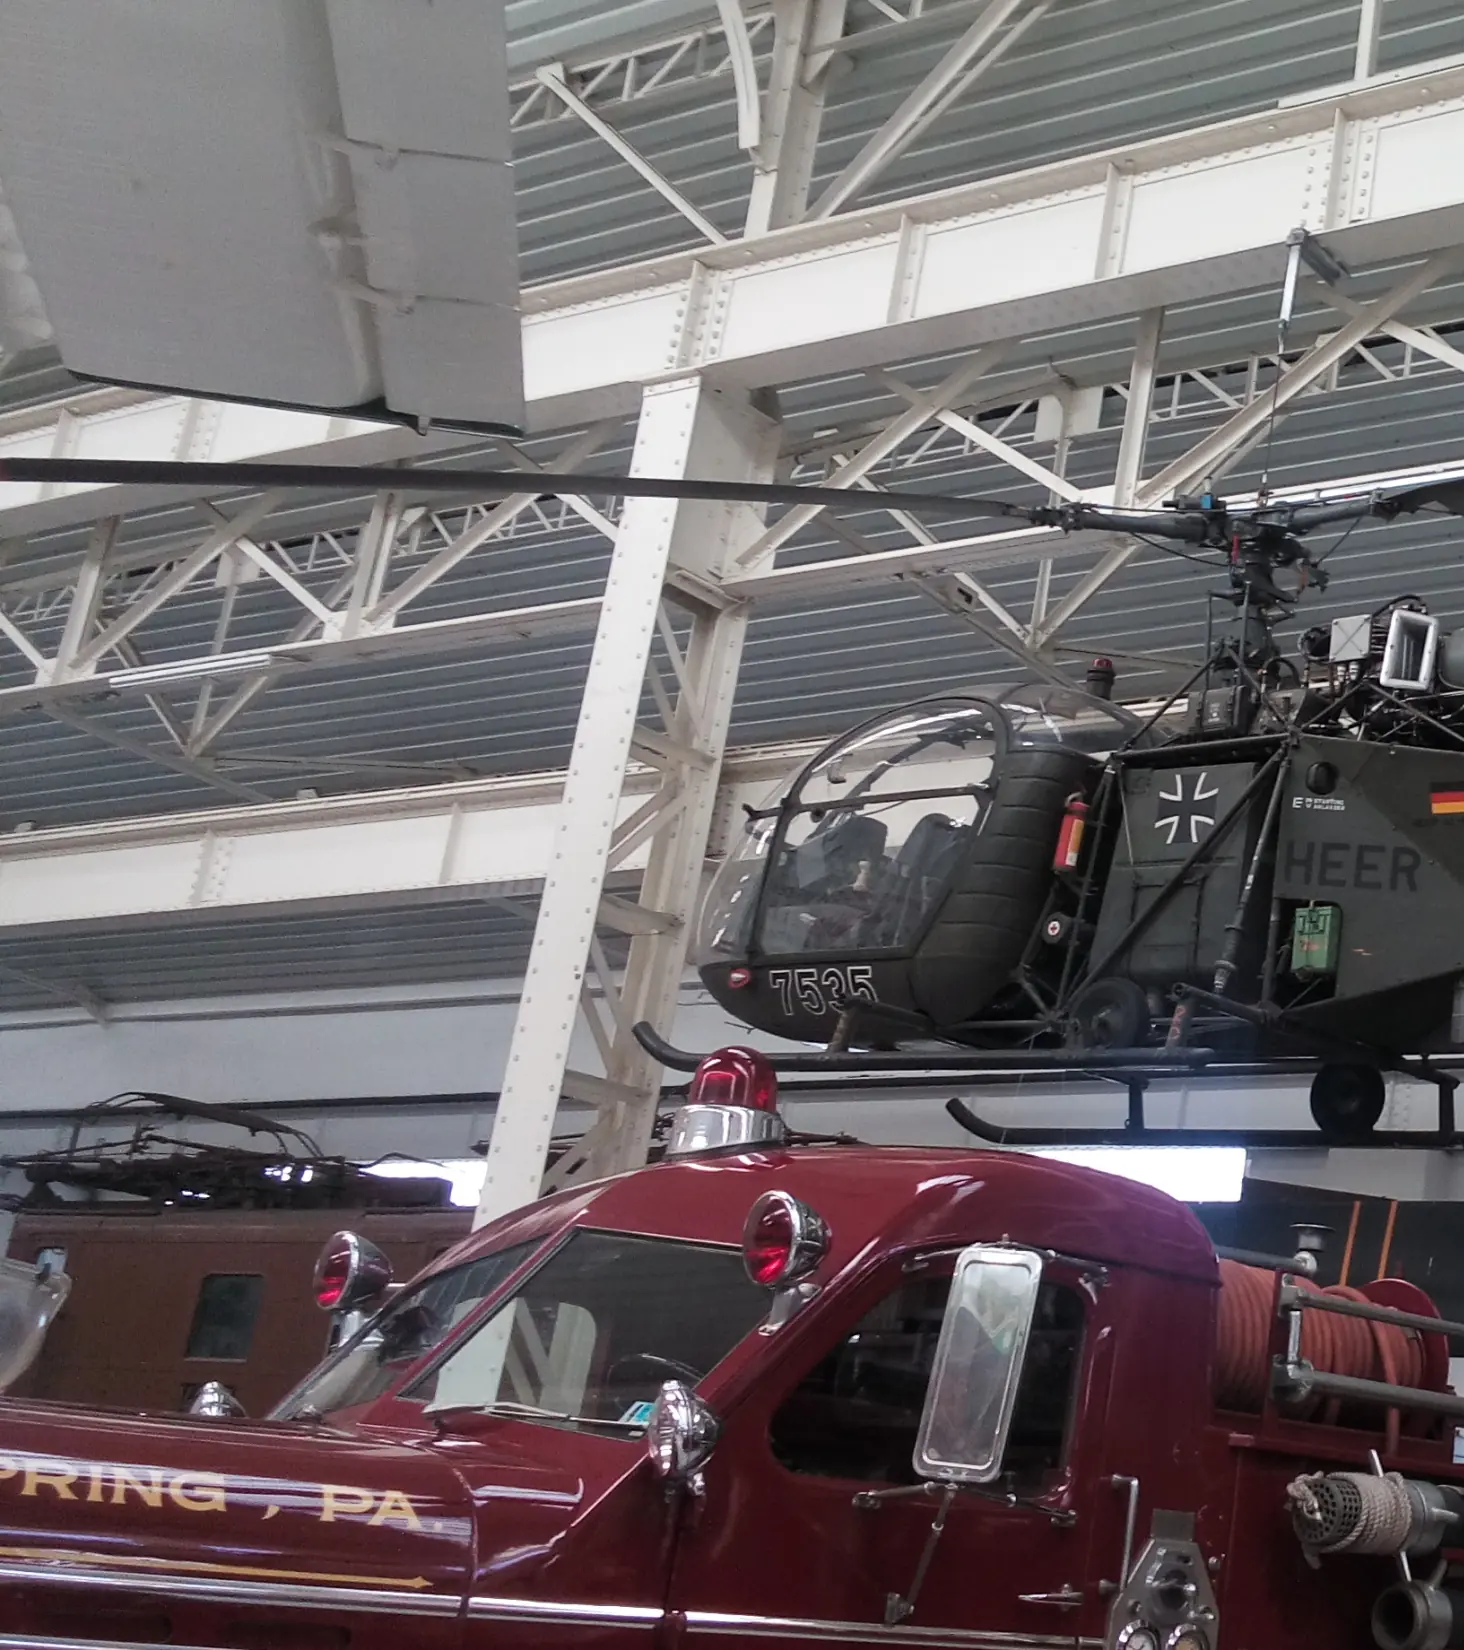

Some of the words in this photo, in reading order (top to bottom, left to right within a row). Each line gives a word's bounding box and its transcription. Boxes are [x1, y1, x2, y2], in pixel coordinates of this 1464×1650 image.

[1284, 840, 1421, 892] HEER
[769, 965, 879, 1016] 7535
[319, 1484, 443, 1533] PA.
